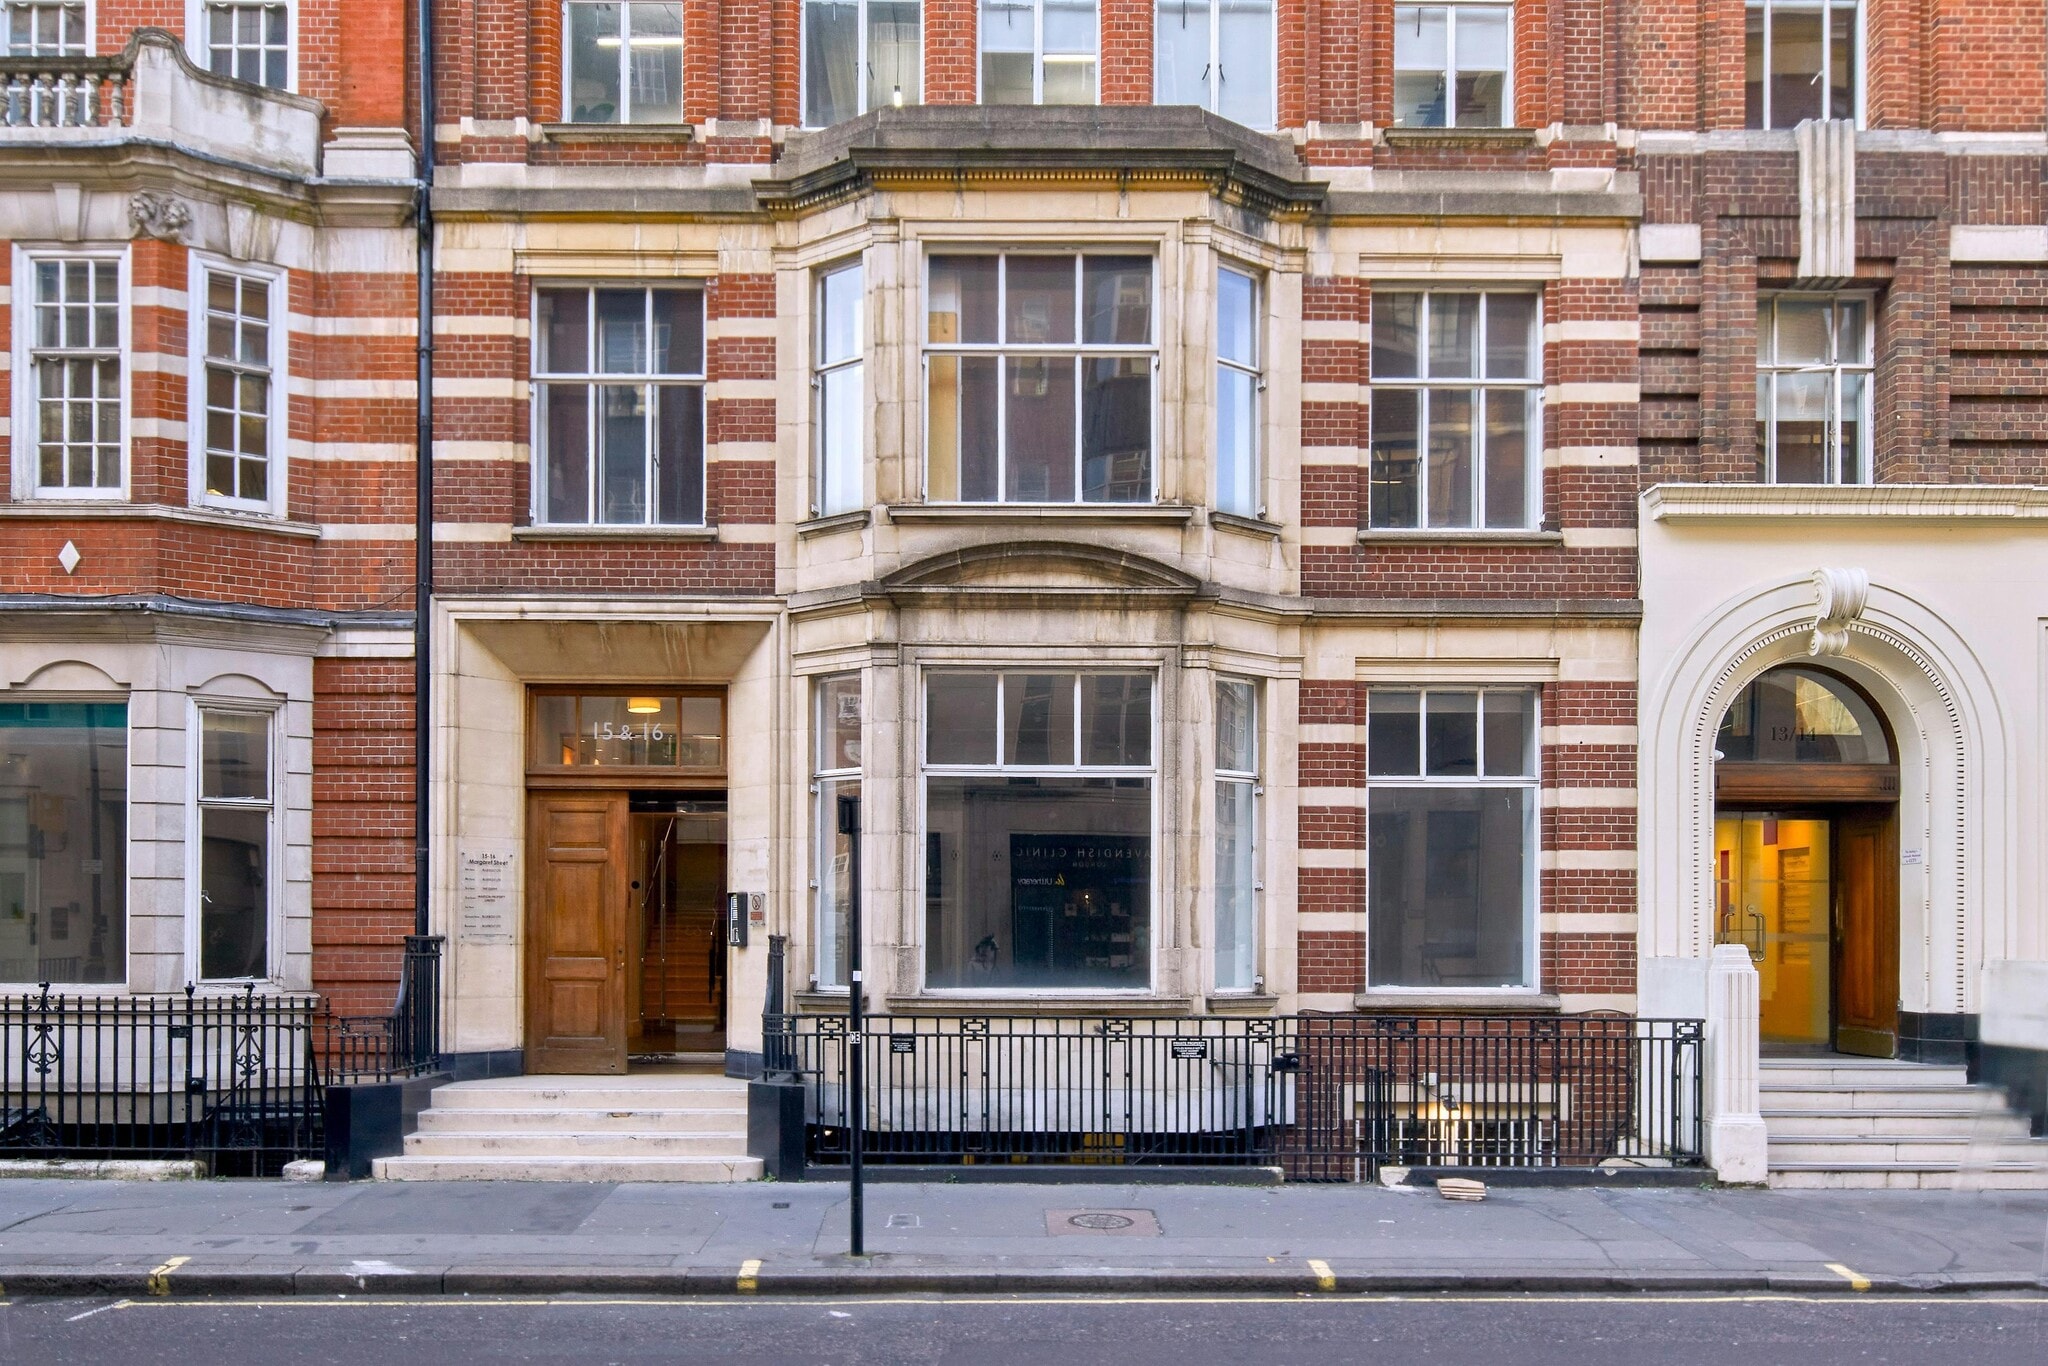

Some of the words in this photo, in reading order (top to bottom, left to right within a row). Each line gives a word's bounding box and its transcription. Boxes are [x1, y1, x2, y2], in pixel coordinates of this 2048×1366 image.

[593, 721, 613, 740] 15
[620, 724, 633, 740] &
[643, 722, 663, 741] 16
[1771, 726, 1816, 741] 13/14
